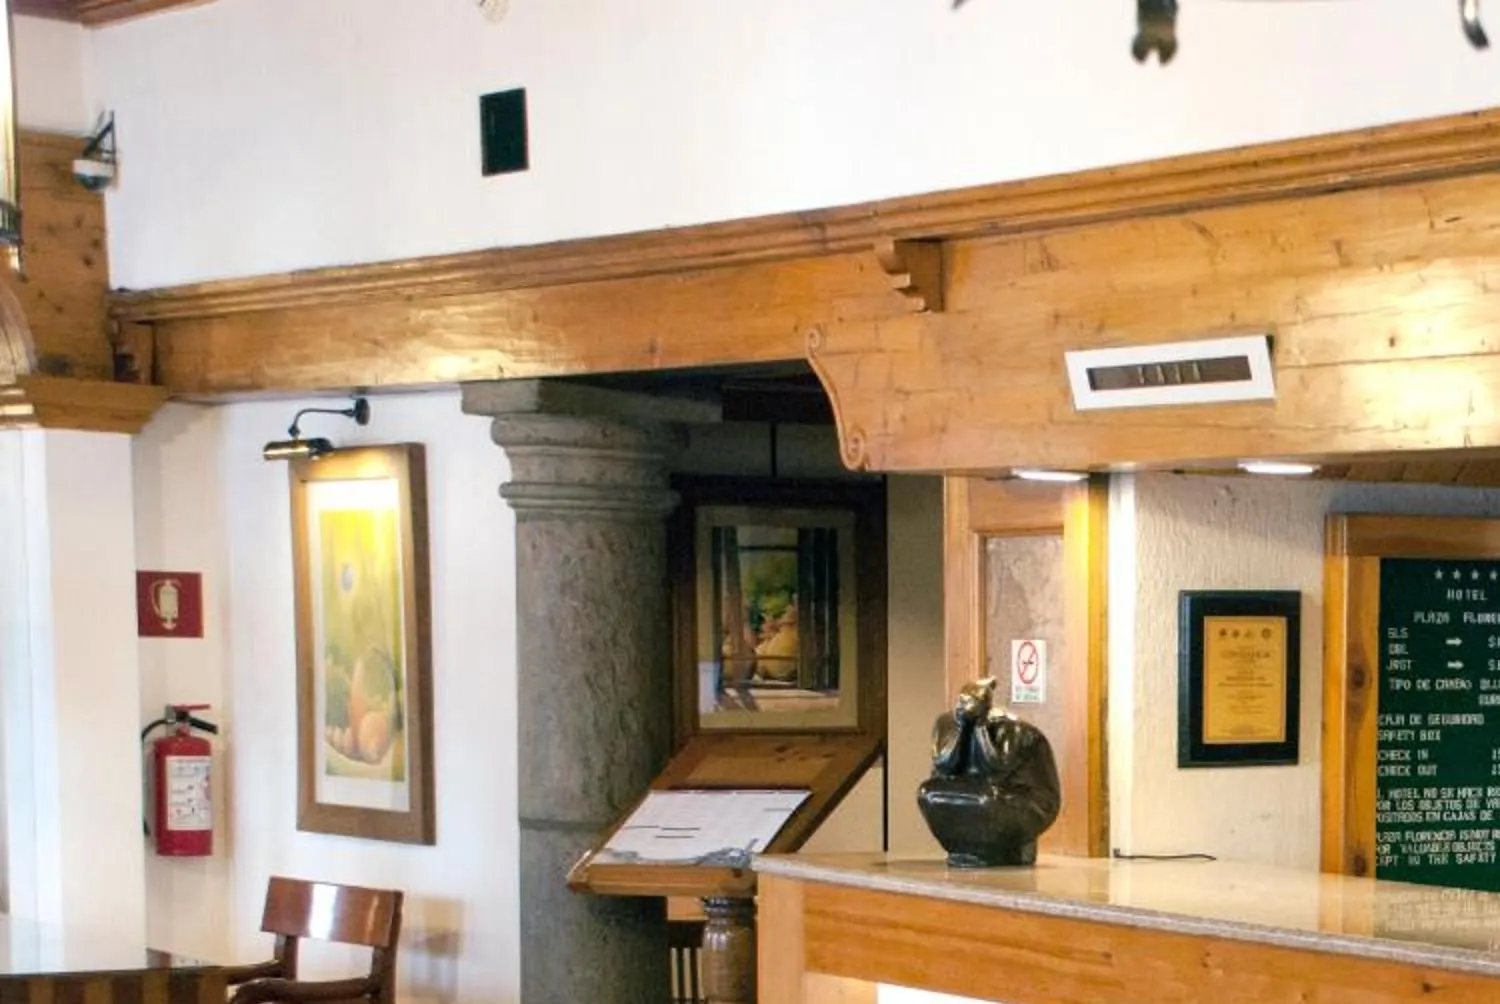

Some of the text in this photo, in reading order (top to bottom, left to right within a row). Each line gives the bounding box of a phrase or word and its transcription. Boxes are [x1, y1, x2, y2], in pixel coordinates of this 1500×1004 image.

[1447, 588, 1487, 601] HOTEL
[1414, 611, 1450, 624] PLAZA
[1420, 730, 1440, 741] BOX
[1378, 750, 1411, 760] CHECK
[1417, 749, 1429, 760] IN
[1378, 765, 1411, 776] CHECK
[1417, 764, 1438, 776] OUT
[1423, 787, 1438, 798] NO
[1396, 800, 1414, 811] LOS
[1425, 811, 1440, 822] EN
[1443, 810, 1476, 822] CAJAS
[1480, 809, 1494, 821] DE
[1428, 853, 1448, 865] THE
